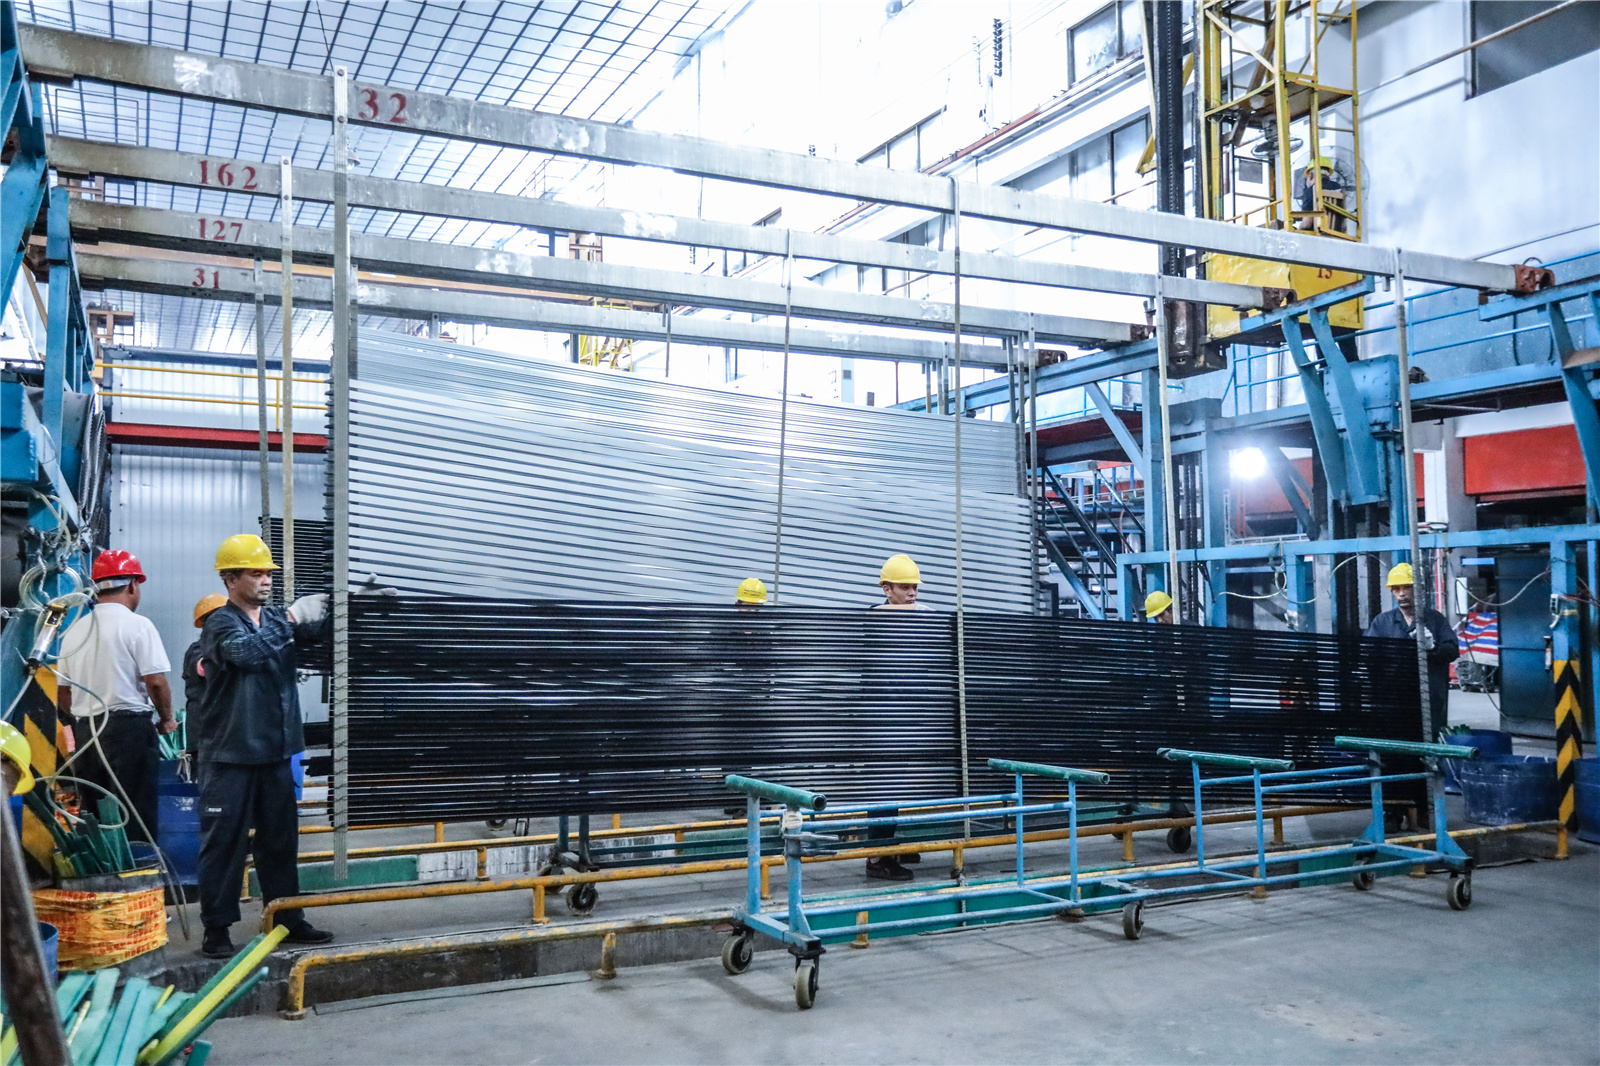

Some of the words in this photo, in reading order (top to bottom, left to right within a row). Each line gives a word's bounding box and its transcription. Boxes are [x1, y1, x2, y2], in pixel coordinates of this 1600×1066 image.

[331, 86, 408, 123] 32
[198, 160, 258, 190] 162
[198, 218, 243, 243] 127
[192, 268, 221, 290] 31
